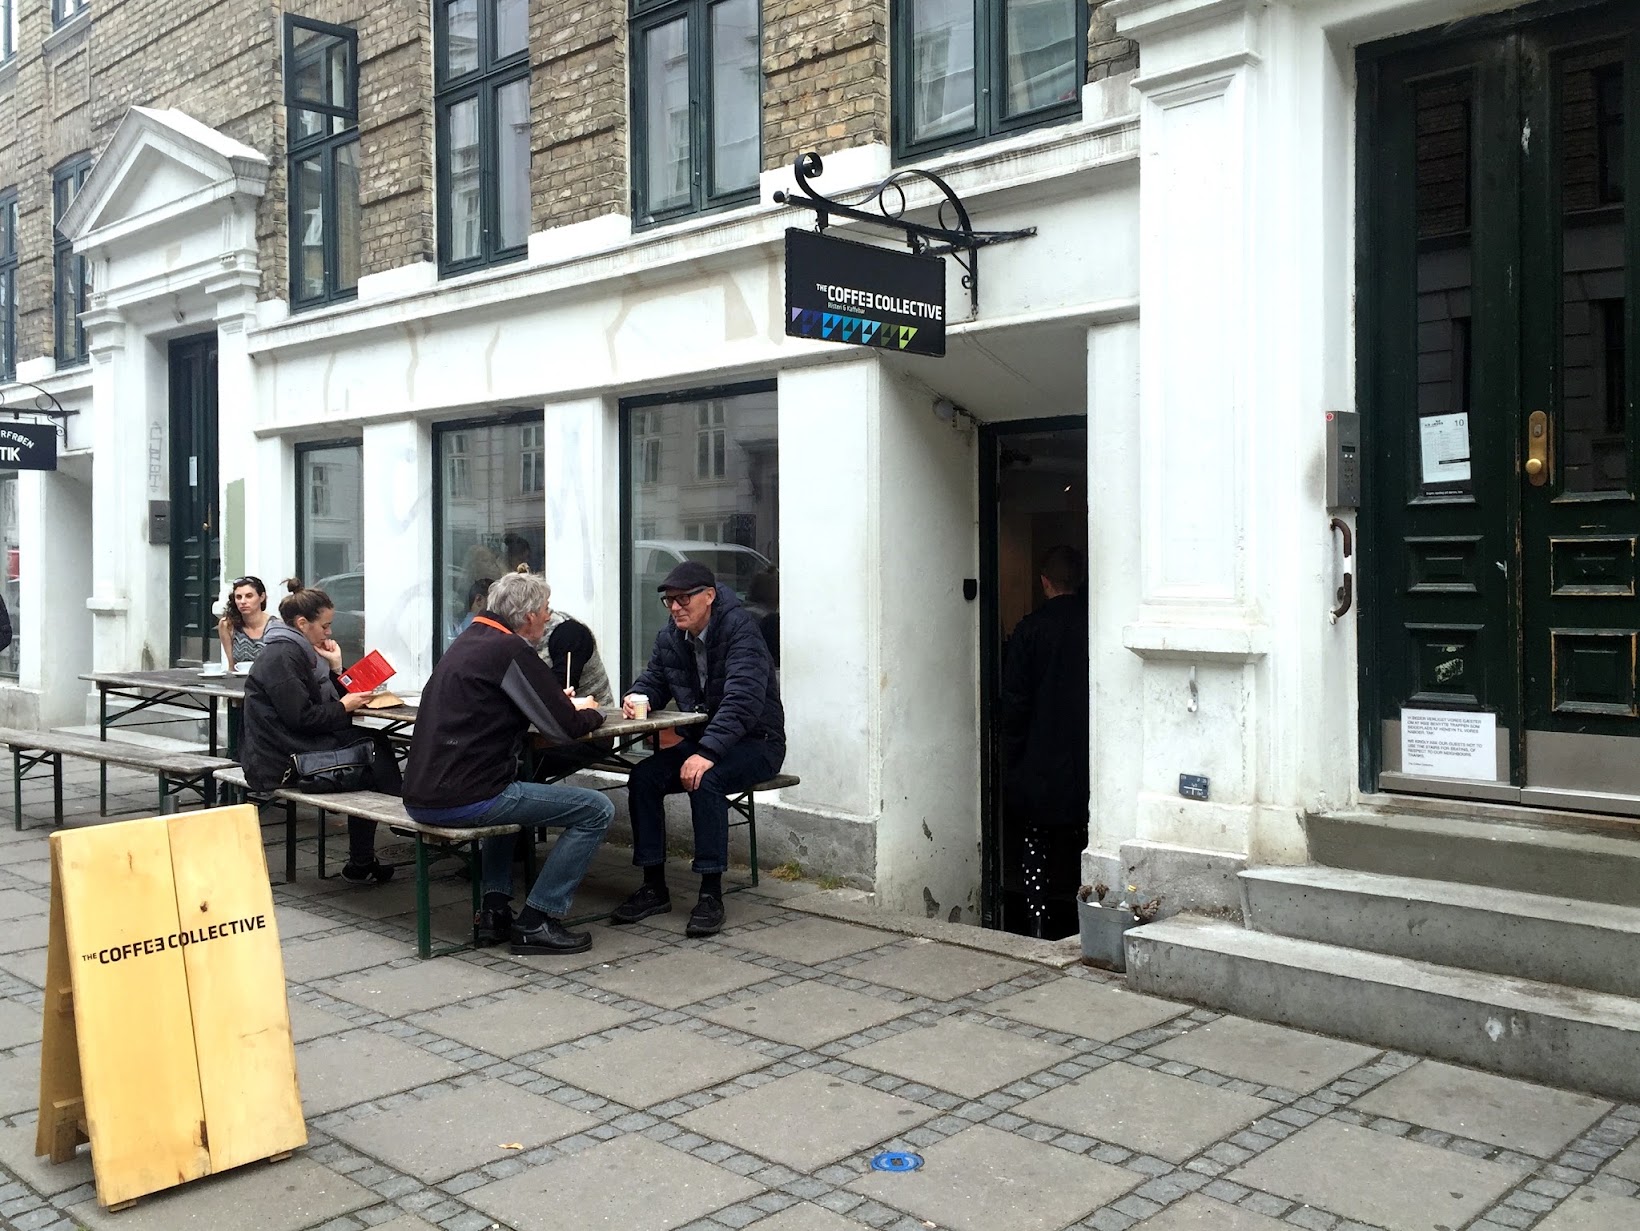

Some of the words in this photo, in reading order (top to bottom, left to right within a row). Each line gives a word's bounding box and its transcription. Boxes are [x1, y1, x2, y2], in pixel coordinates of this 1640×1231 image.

[816, 283, 828, 292] THE
[828, 285, 874, 308] COFFEE
[875, 294, 942, 320] COLLECTIVE
[0, 447, 20, 461] TIK
[82, 952, 97, 962] THE
[99, 937, 166, 964] COFFEE
[168, 915, 266, 949] COLLECTIVE
